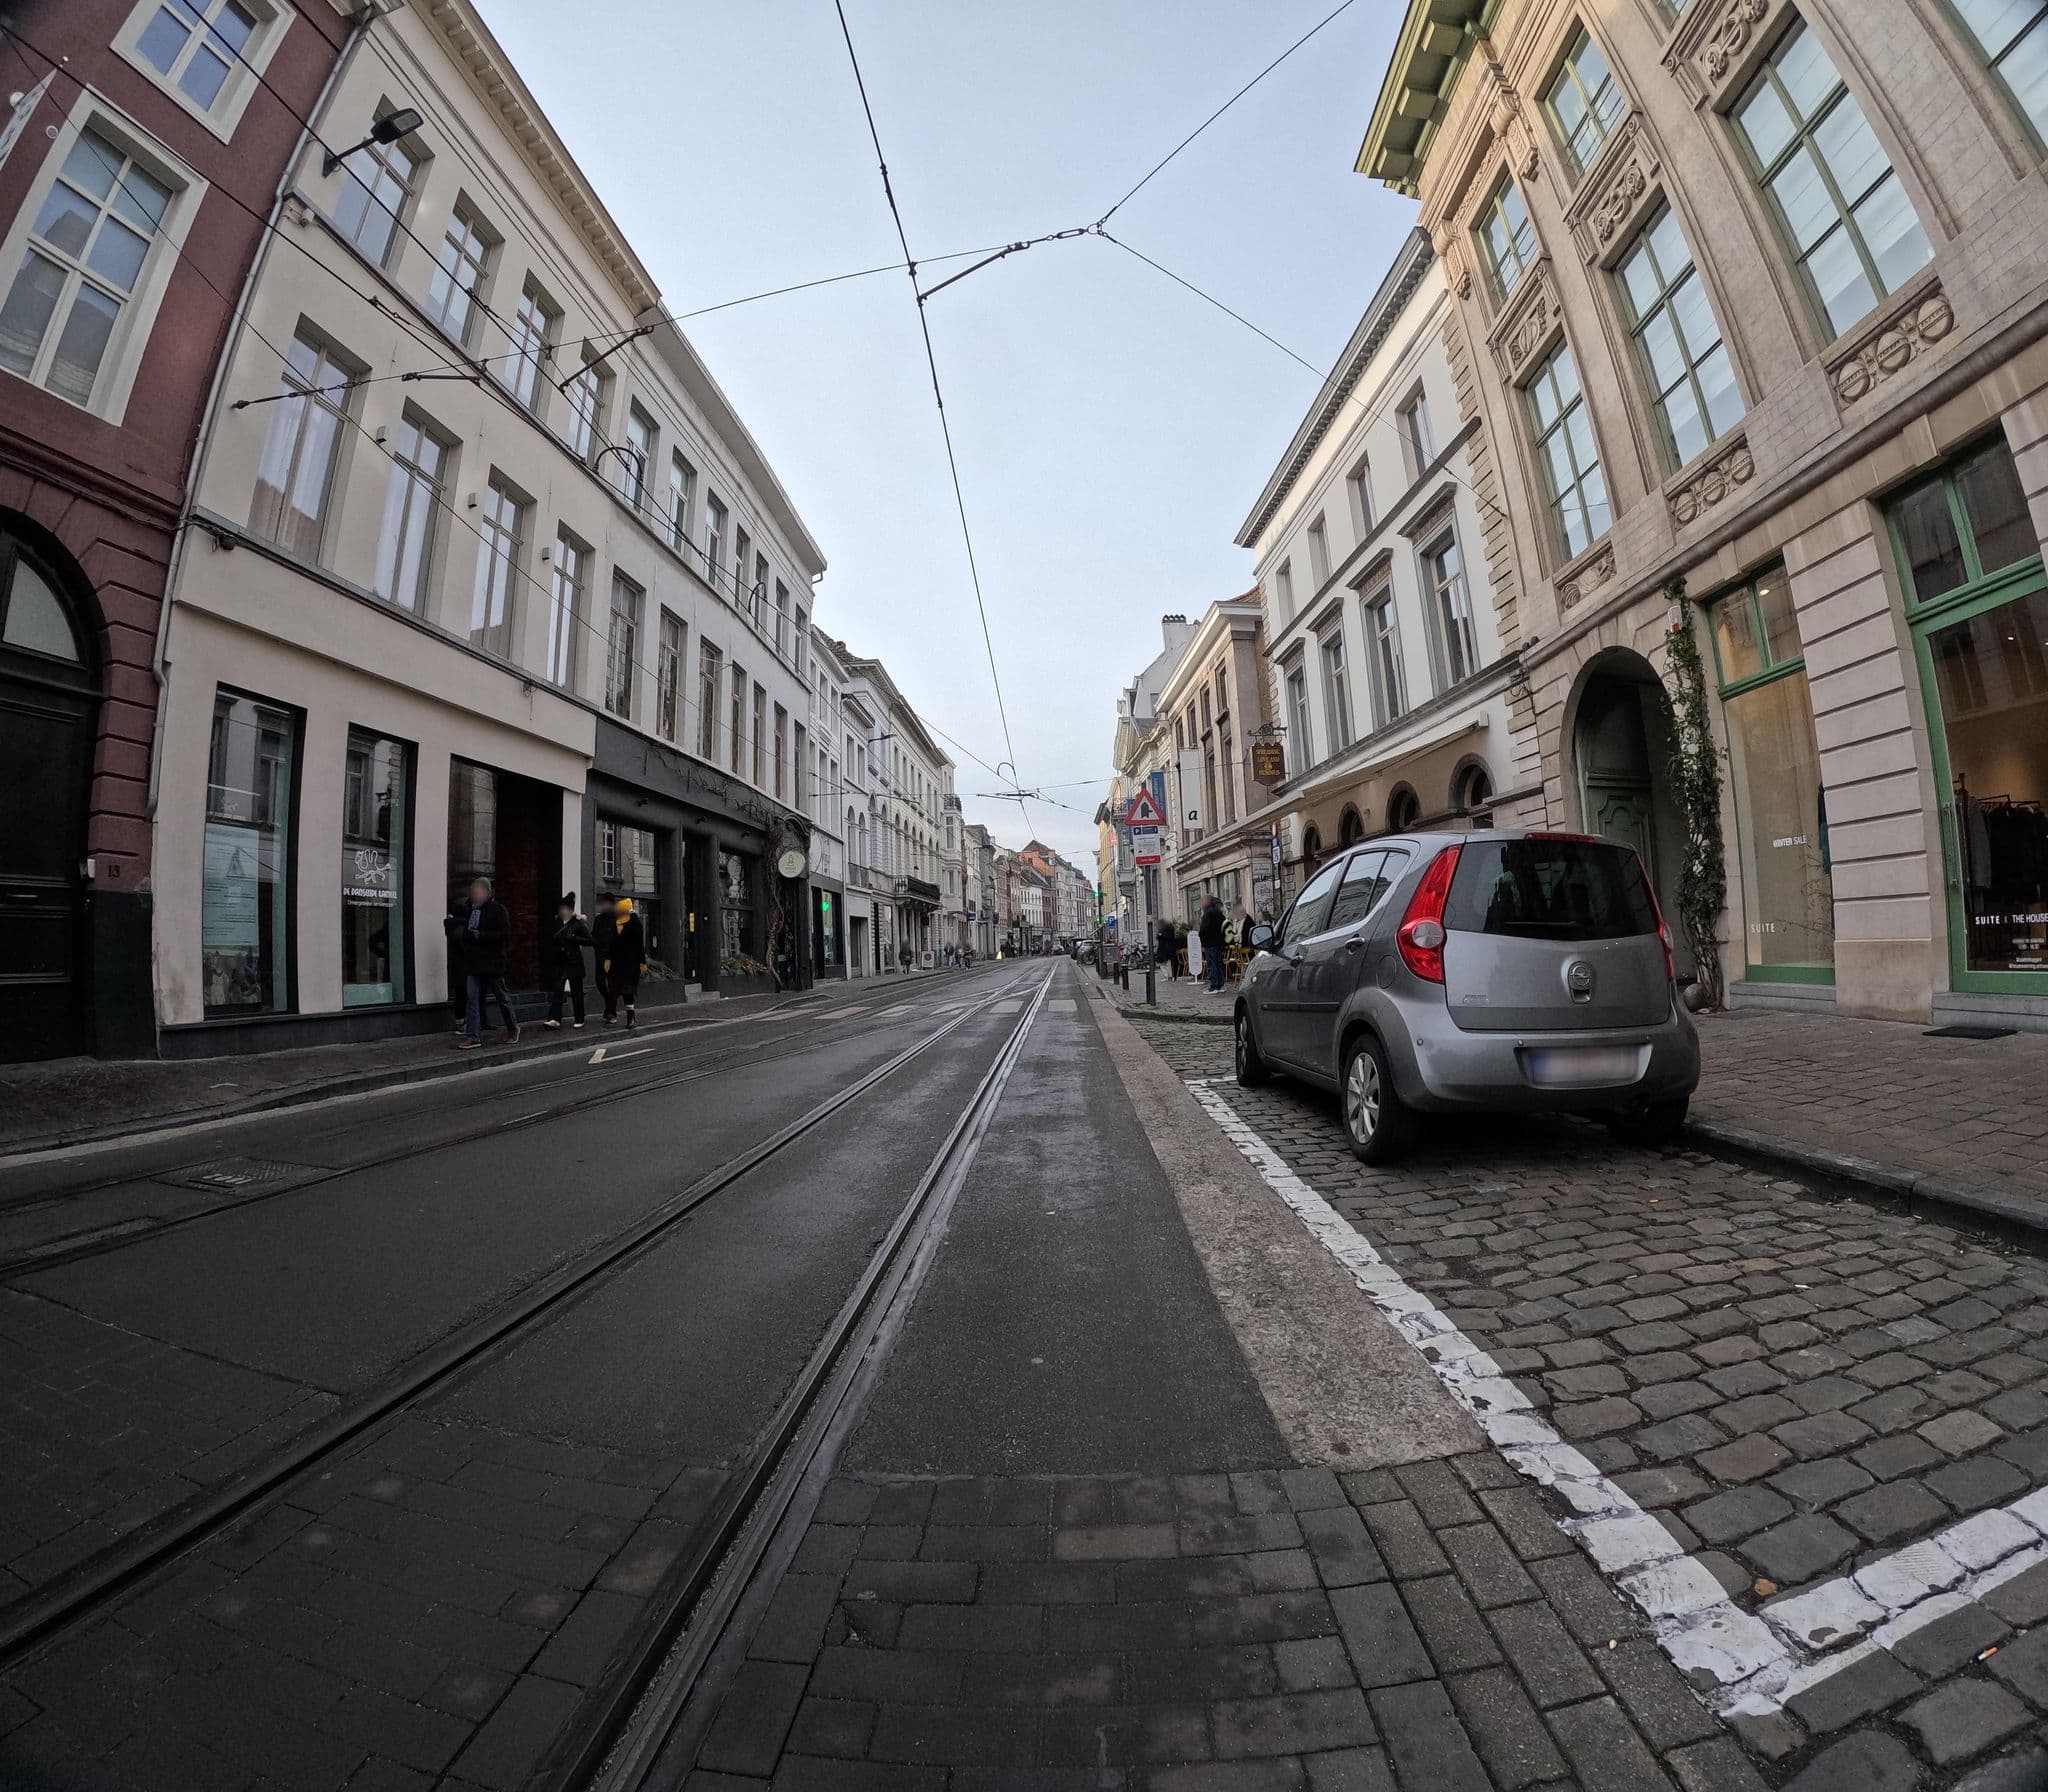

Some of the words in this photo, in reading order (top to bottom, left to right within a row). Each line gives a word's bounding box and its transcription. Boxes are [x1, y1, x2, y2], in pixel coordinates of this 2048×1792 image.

[1188, 810, 1198, 820] a
[1772, 838, 1792, 848] WINTER
[1793, 836, 1808, 846] SALE
[108, 865, 120, 878] 13
[1976, 916, 2000, 925] SUITE
[2012, 914, 2024, 923] THE
[2026, 913, 2048, 923] HOUSE
[1750, 922, 1776, 933] SUITE
